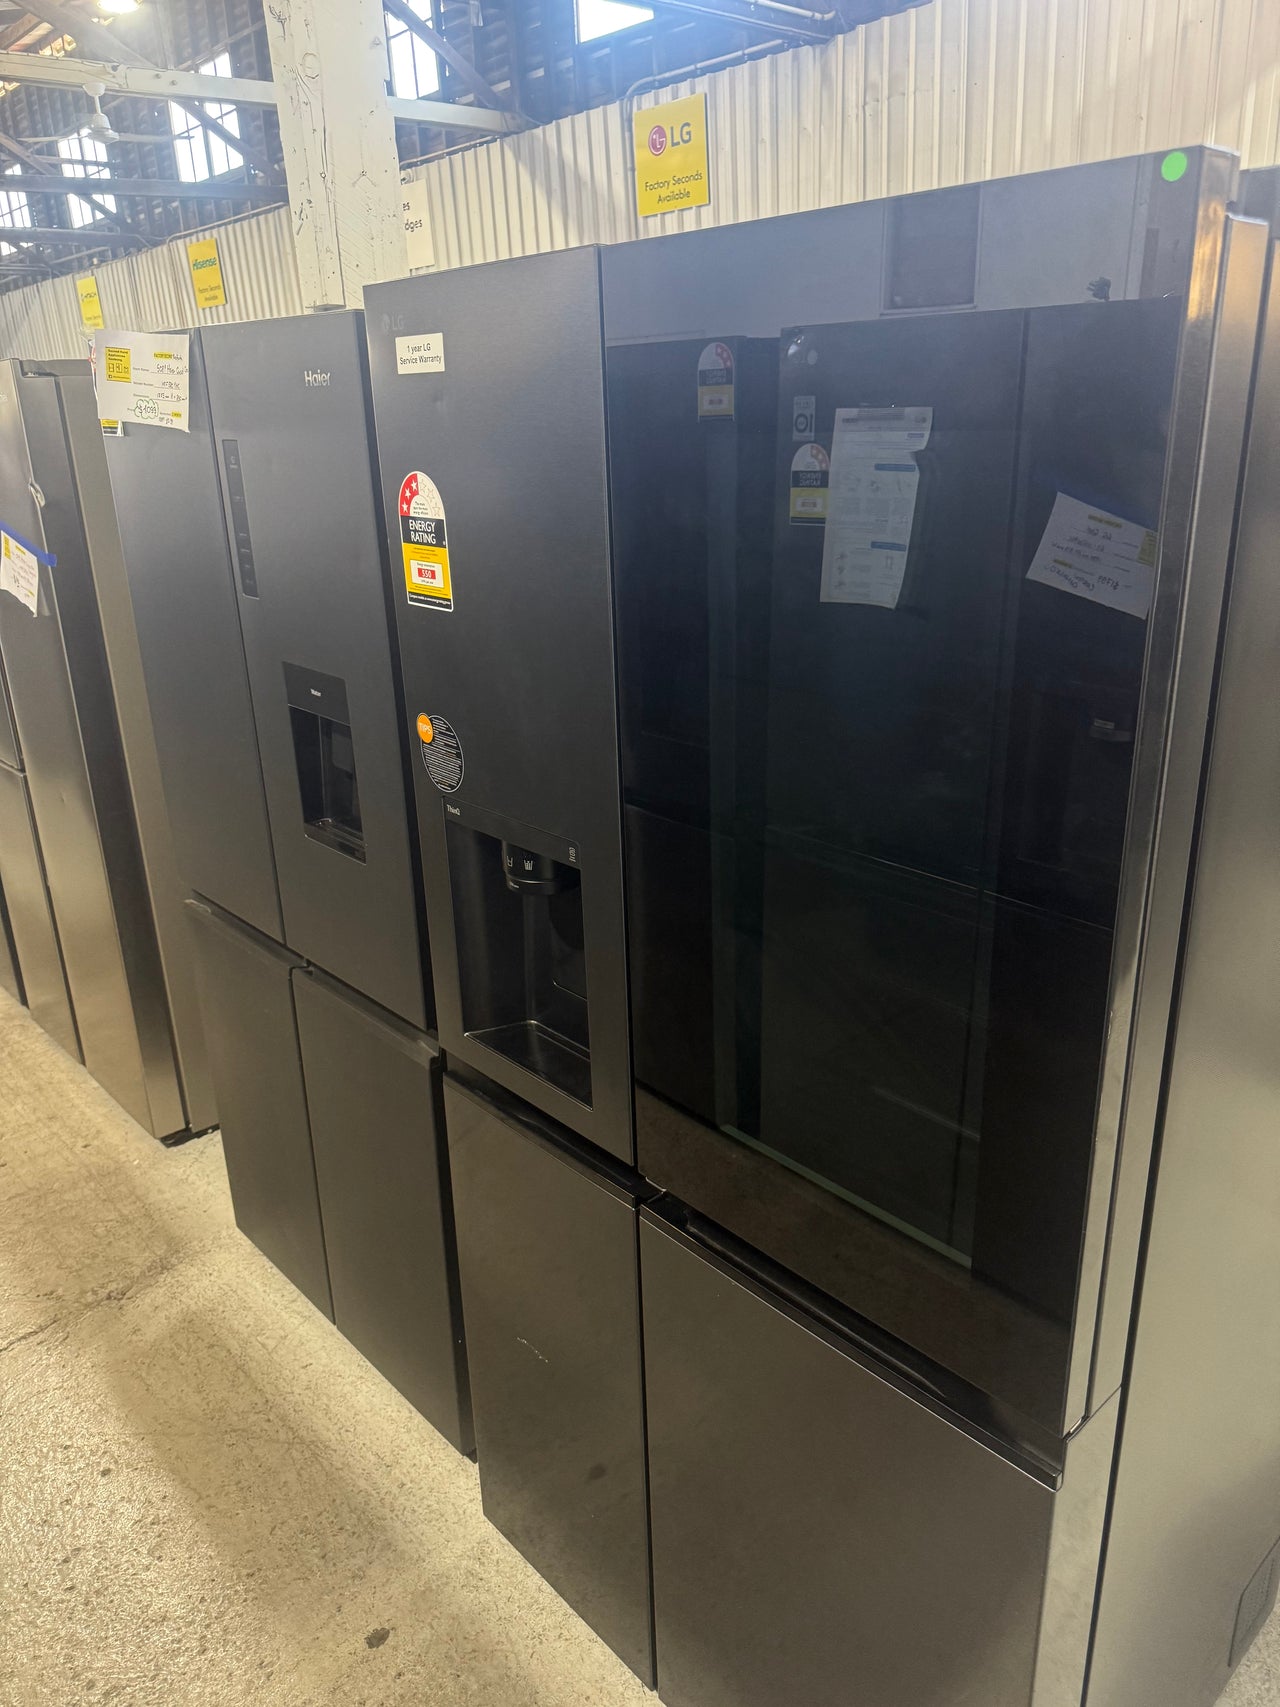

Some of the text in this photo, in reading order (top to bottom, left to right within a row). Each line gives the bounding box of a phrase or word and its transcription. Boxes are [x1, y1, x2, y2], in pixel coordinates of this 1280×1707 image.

[670, 122, 692, 148] LG
[644, 170, 703, 192] Factory Seconds
[657, 188, 691, 204] Available
[411, 345, 422, 354] year
[423, 342, 431, 352] LG
[400, 354, 441, 365] Service Warranty
[304, 369, 330, 387] Haier
[409, 519, 435, 532] ENERGY
[410, 531, 436, 544] RATING
